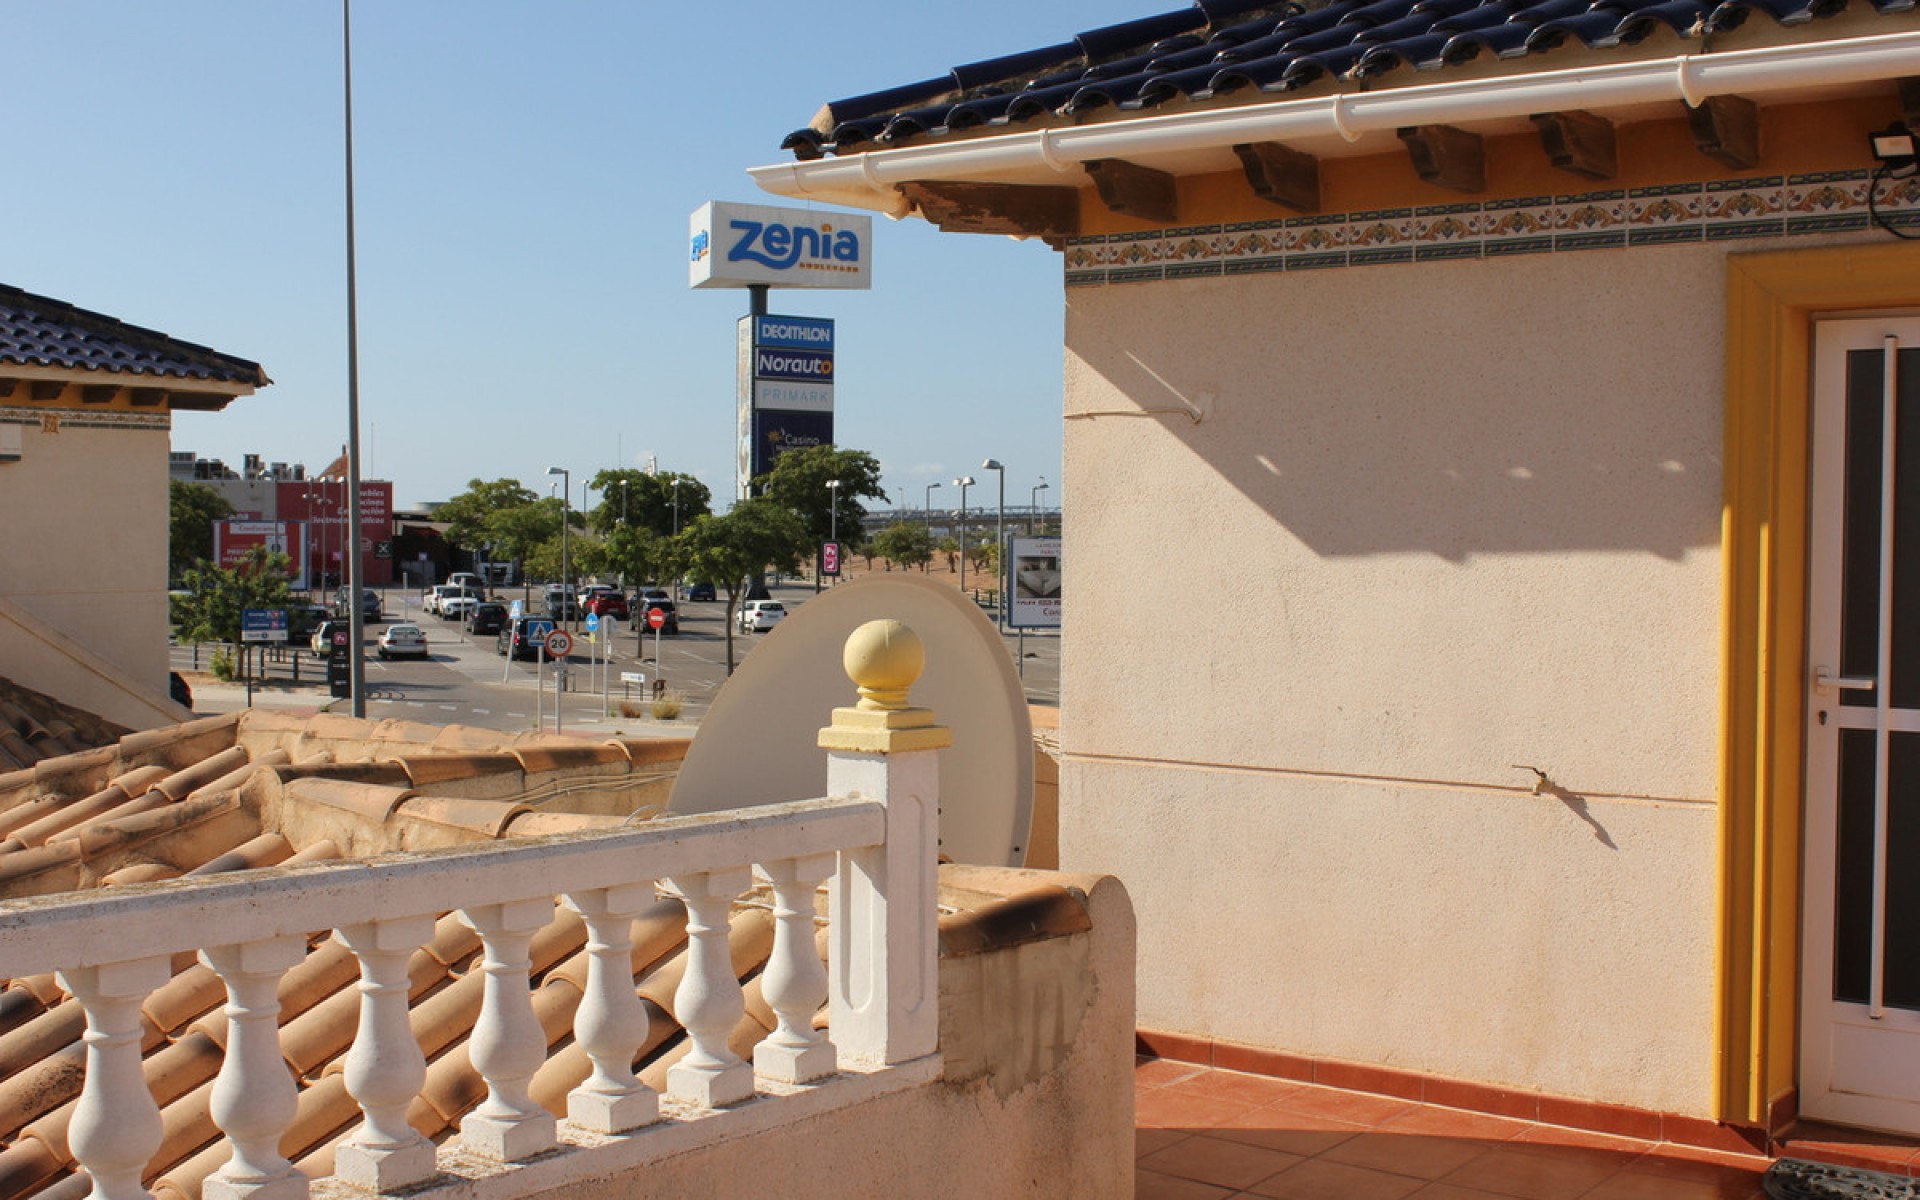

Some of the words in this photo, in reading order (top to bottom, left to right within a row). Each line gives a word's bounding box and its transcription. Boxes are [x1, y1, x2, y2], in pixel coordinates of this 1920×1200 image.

[762, 323, 830, 341] DECATHLON
[759, 354, 832, 374] Norauto
[762, 387, 828, 401] PRIMARK
[785, 433, 820, 446] Casino
[551, 639, 567, 649] 20
